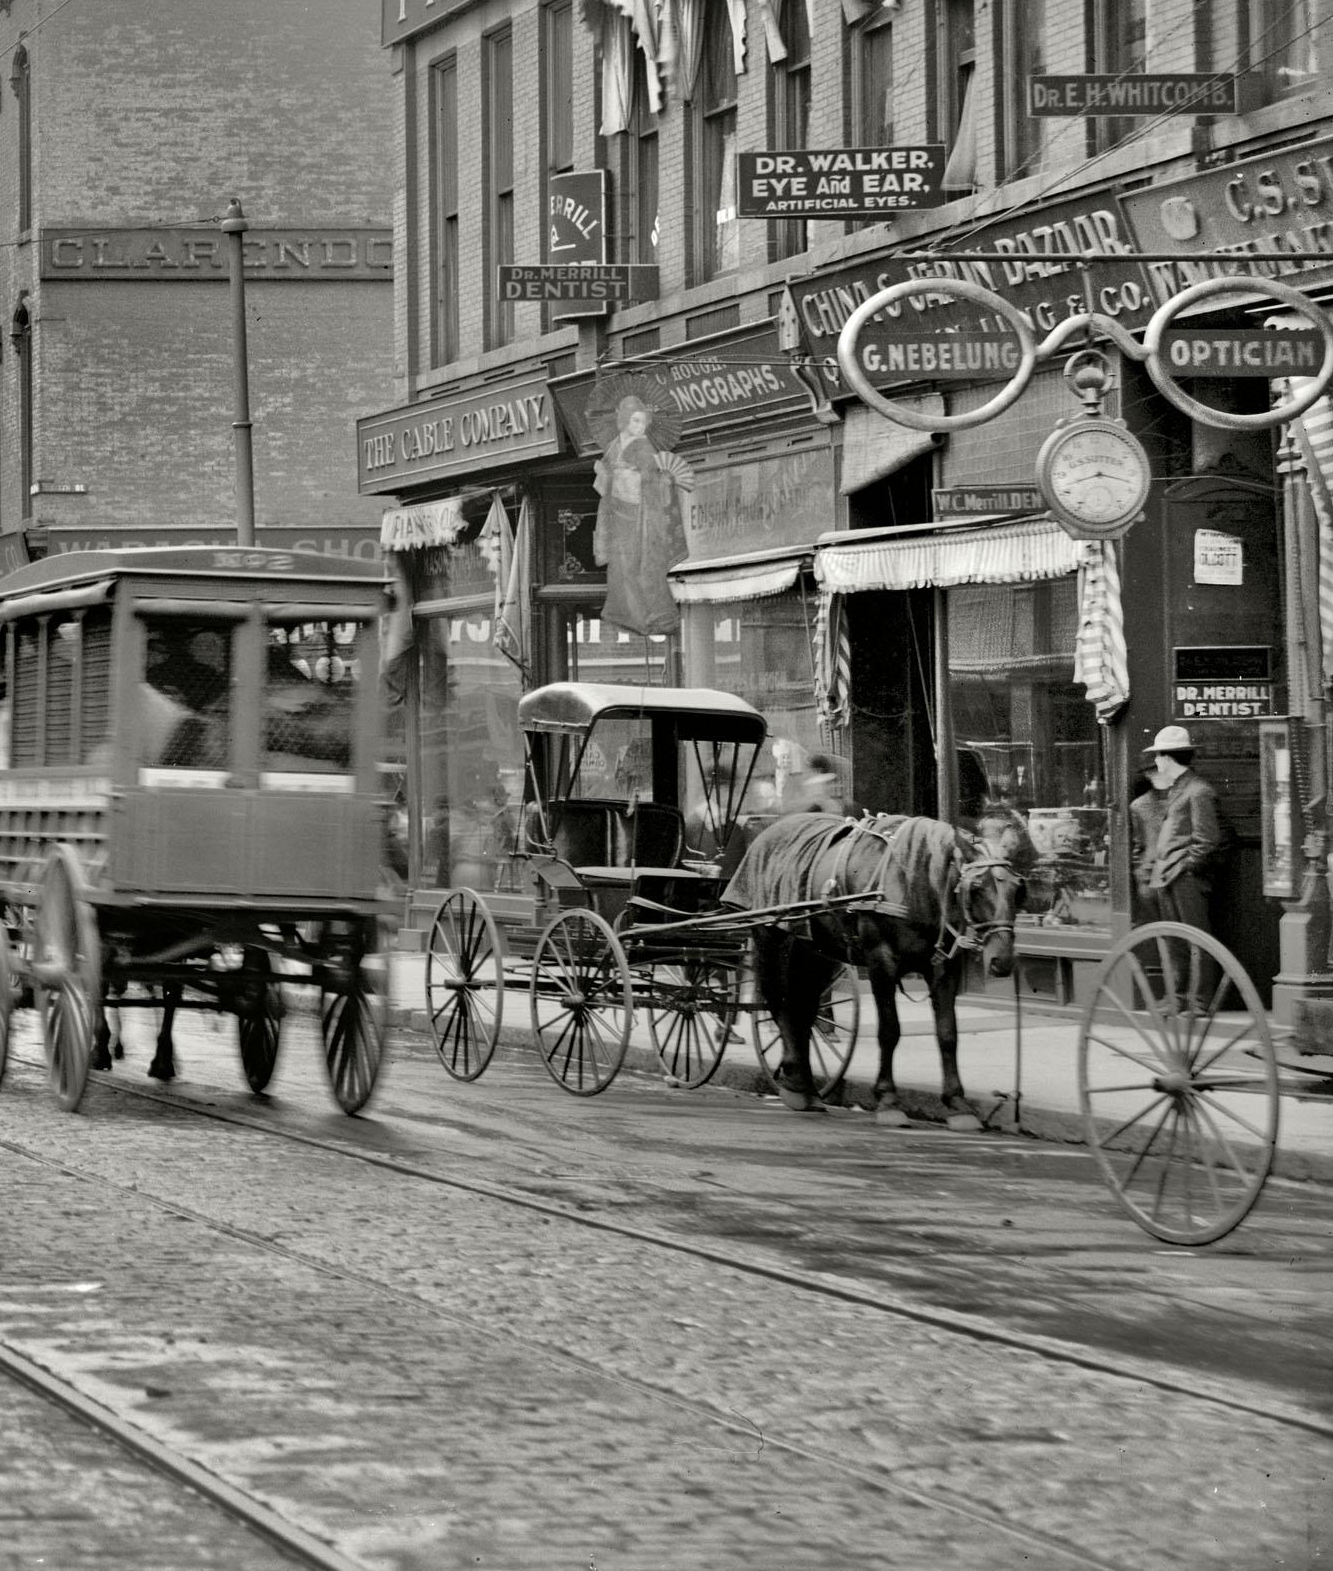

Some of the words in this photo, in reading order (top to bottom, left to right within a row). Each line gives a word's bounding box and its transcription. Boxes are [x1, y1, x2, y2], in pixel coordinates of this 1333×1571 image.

[755, 157, 804, 175] DR.
[752, 178, 807, 198] EYE
[765, 199, 859, 212] ARTIFICIAL
[865, 196, 917, 210] EYES.
[506, 281, 627, 299] DENTIST
[1099, 281, 1151, 316] CO.
[1170, 339, 1316, 367] OPTICIAN
[364, 433, 395, 470] THE
[401, 417, 455, 460] CABLE
[460, 394, 550, 447] COMPANY.
